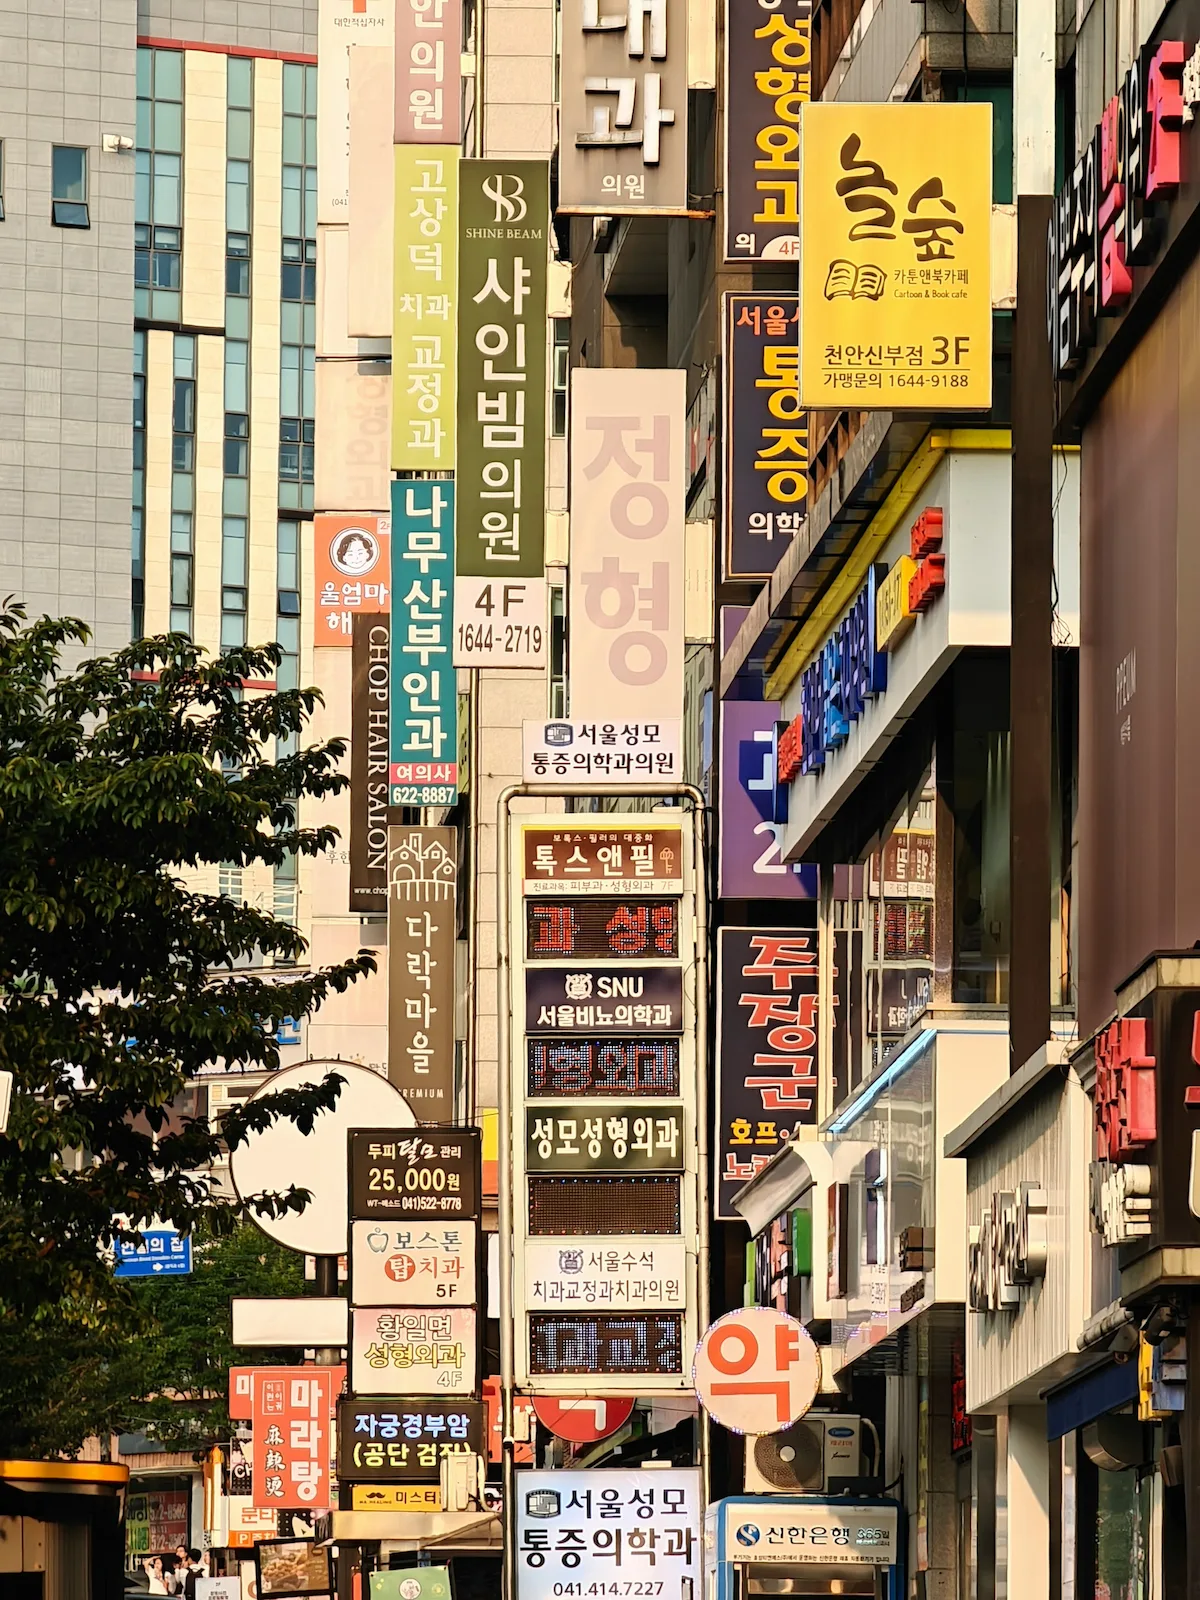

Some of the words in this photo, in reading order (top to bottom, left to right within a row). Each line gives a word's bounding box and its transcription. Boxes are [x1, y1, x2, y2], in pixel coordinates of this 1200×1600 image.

[601, 175, 645, 200] 의원
[466, 228, 504, 238] SHINE
[506, 228, 542, 239] BEAM
[894, 269, 969, 285] 카툰앤북카페
[400, 293, 452, 321] 치과
[894, 289, 923, 299] Cartoon
[932, 289, 950, 299] Book
[951, 289, 968, 299] cafe
[736, 305, 799, 336] 서울
[824, 345, 923, 367] 천안신부점
[932, 336, 970, 365] 3F
[823, 373, 882, 390] 가맹문의
[889, 374, 969, 388] 1644-9188
[405, 335, 447, 459] 교정과
[754, 345, 808, 503] 통증
[579, 414, 672, 688] 정형
[474, 585, 526, 617] 4F
[402, 486, 448, 758] 나무산부인과
[459, 623, 542, 655] 1644-2719
[367, 625, 389, 703] CHOP
[367, 708, 389, 777] HAIR
[579, 723, 660, 746] 서울성모
[396, 766, 451, 784] 여의사
[531, 751, 674, 776] 통증의학과의원
[393, 787, 454, 804] 622-8887
[367, 782, 389, 871] SALON
[532, 844, 655, 876] 톡스앤필
[661, 881, 674, 890] 7F
[404, 911, 439, 1075] 다락마을
[597, 976, 644, 998] SNU
[536, 1004, 673, 1028] 서울비뇨의학과
[742, 934, 841, 1110] 주장군
[367, 1142, 396, 1160] 두피
[440, 1145, 462, 1159] 관리
[531, 1117, 680, 1160] 성모성형외과
[369, 1167, 461, 1194] 25,000원
[402, 1196, 462, 1210] 041)522-8778
[393, 1230, 463, 1253] 보스톤
[587, 1249, 654, 1272] 서울수석
[436, 1284, 457, 1298] 5F
[532, 1278, 680, 1303] 치과교정과치과의원
[376, 1314, 453, 1342] 황일면
[365, 1342, 467, 1369] 성형외과
[437, 1371, 463, 1387] 4F
[707, 1323, 800, 1423] 약
[354, 1413, 470, 1439] 자궁경부암
[290, 1379, 323, 1501] 마라탕
[353, 1441, 410, 1468] (공단
[565, 1488, 689, 1519] 서울성모
[519, 1526, 700, 1569] 통증의학과
[765, 1526, 850, 1546] 신한은행
[552, 1581, 664, 1599] 041.414.7227
